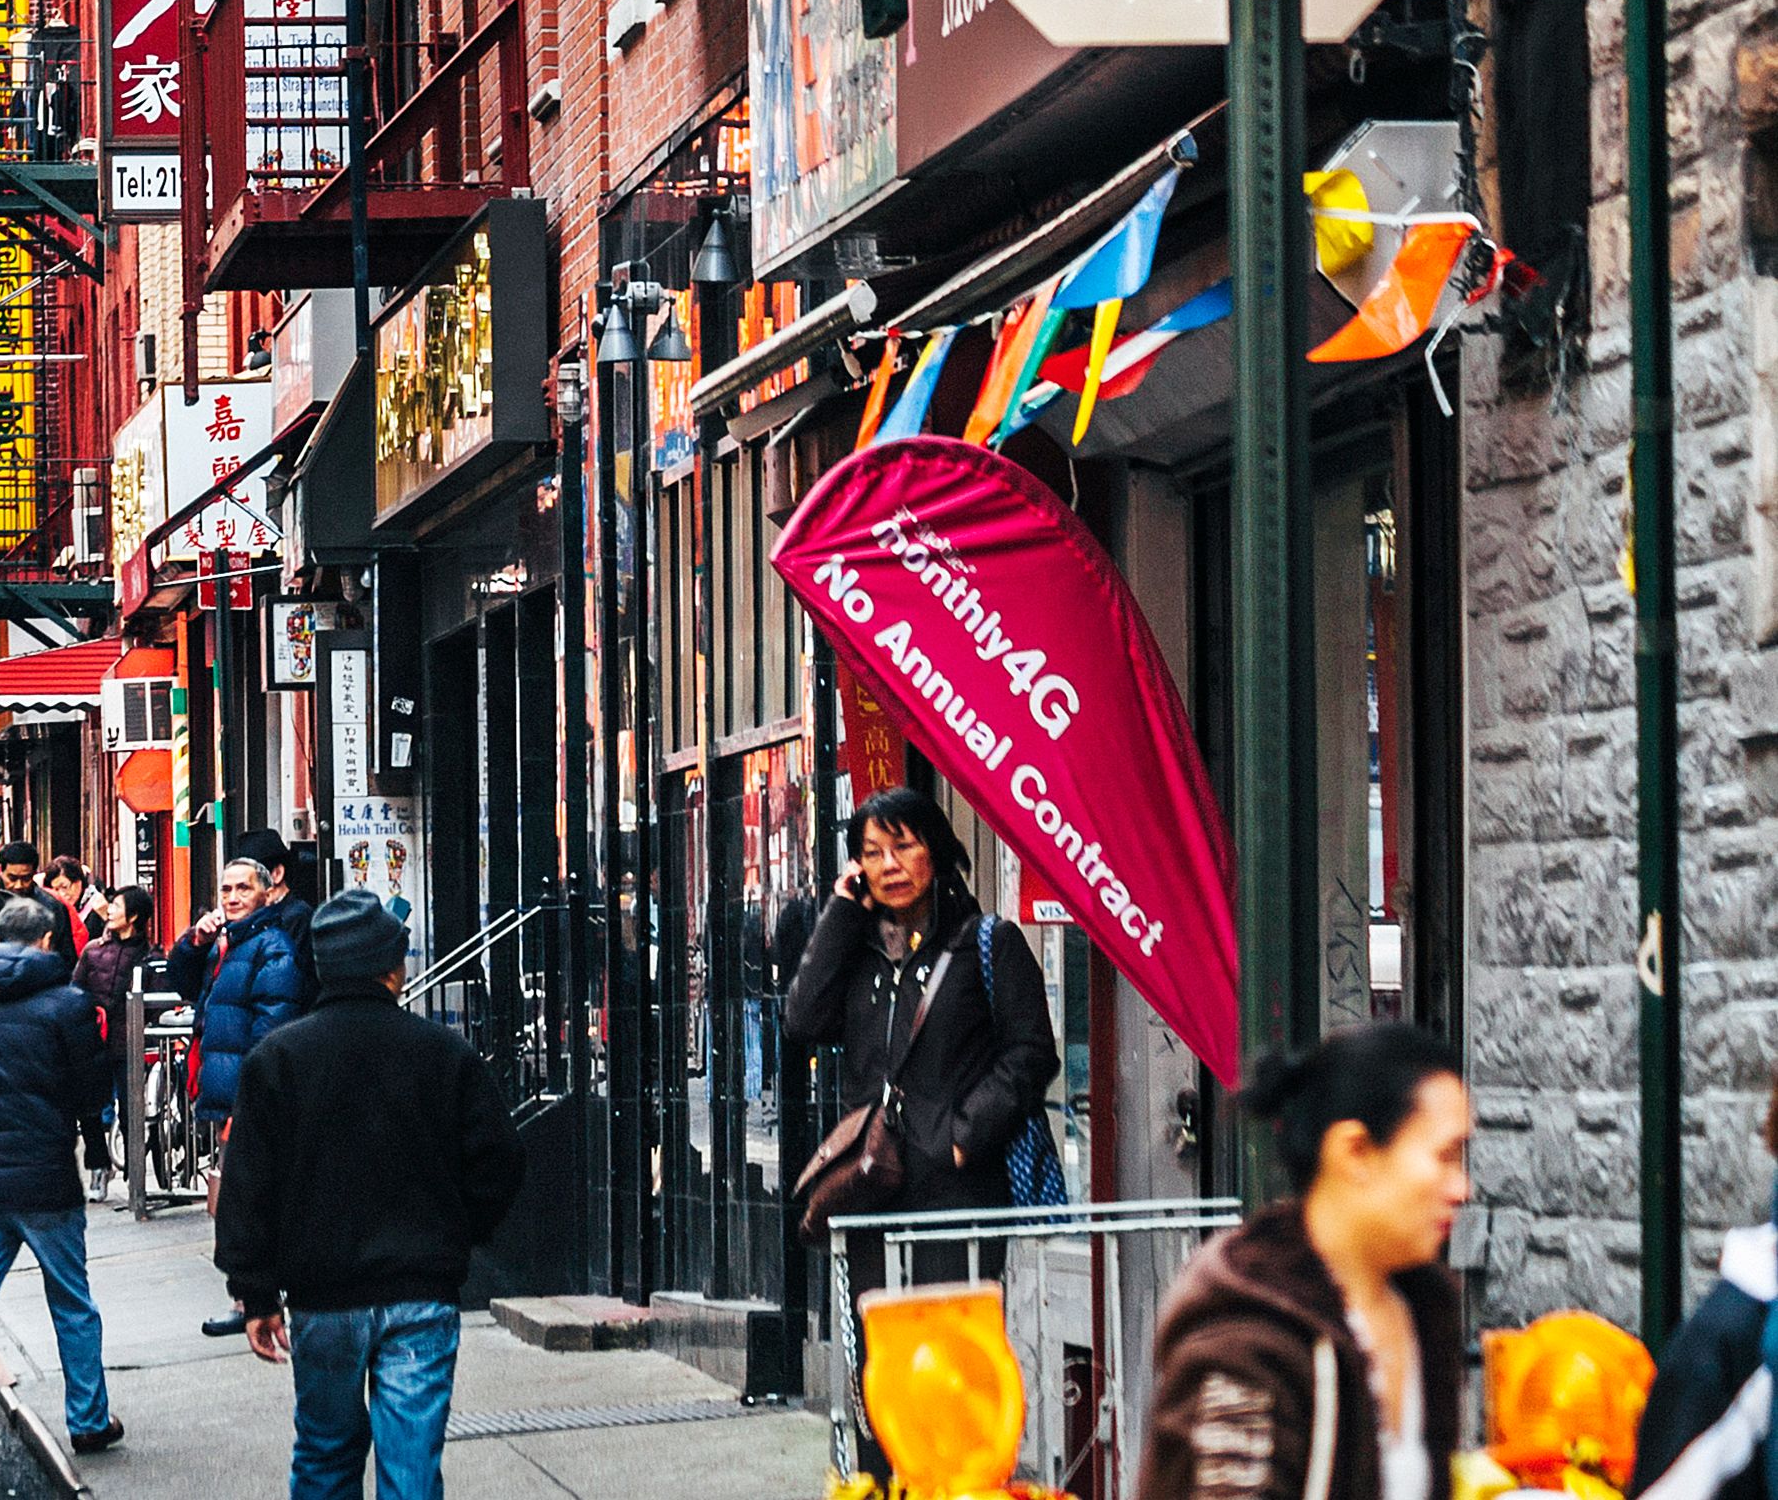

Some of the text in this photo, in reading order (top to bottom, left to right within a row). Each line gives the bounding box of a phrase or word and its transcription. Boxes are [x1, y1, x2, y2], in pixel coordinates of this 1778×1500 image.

[813, 552, 875, 624] No
[874, 620, 1013, 771] Annual
[339, 823, 371, 836] Health
[374, 823, 396, 835] Trail
[1010, 763, 1165, 957] Contract
